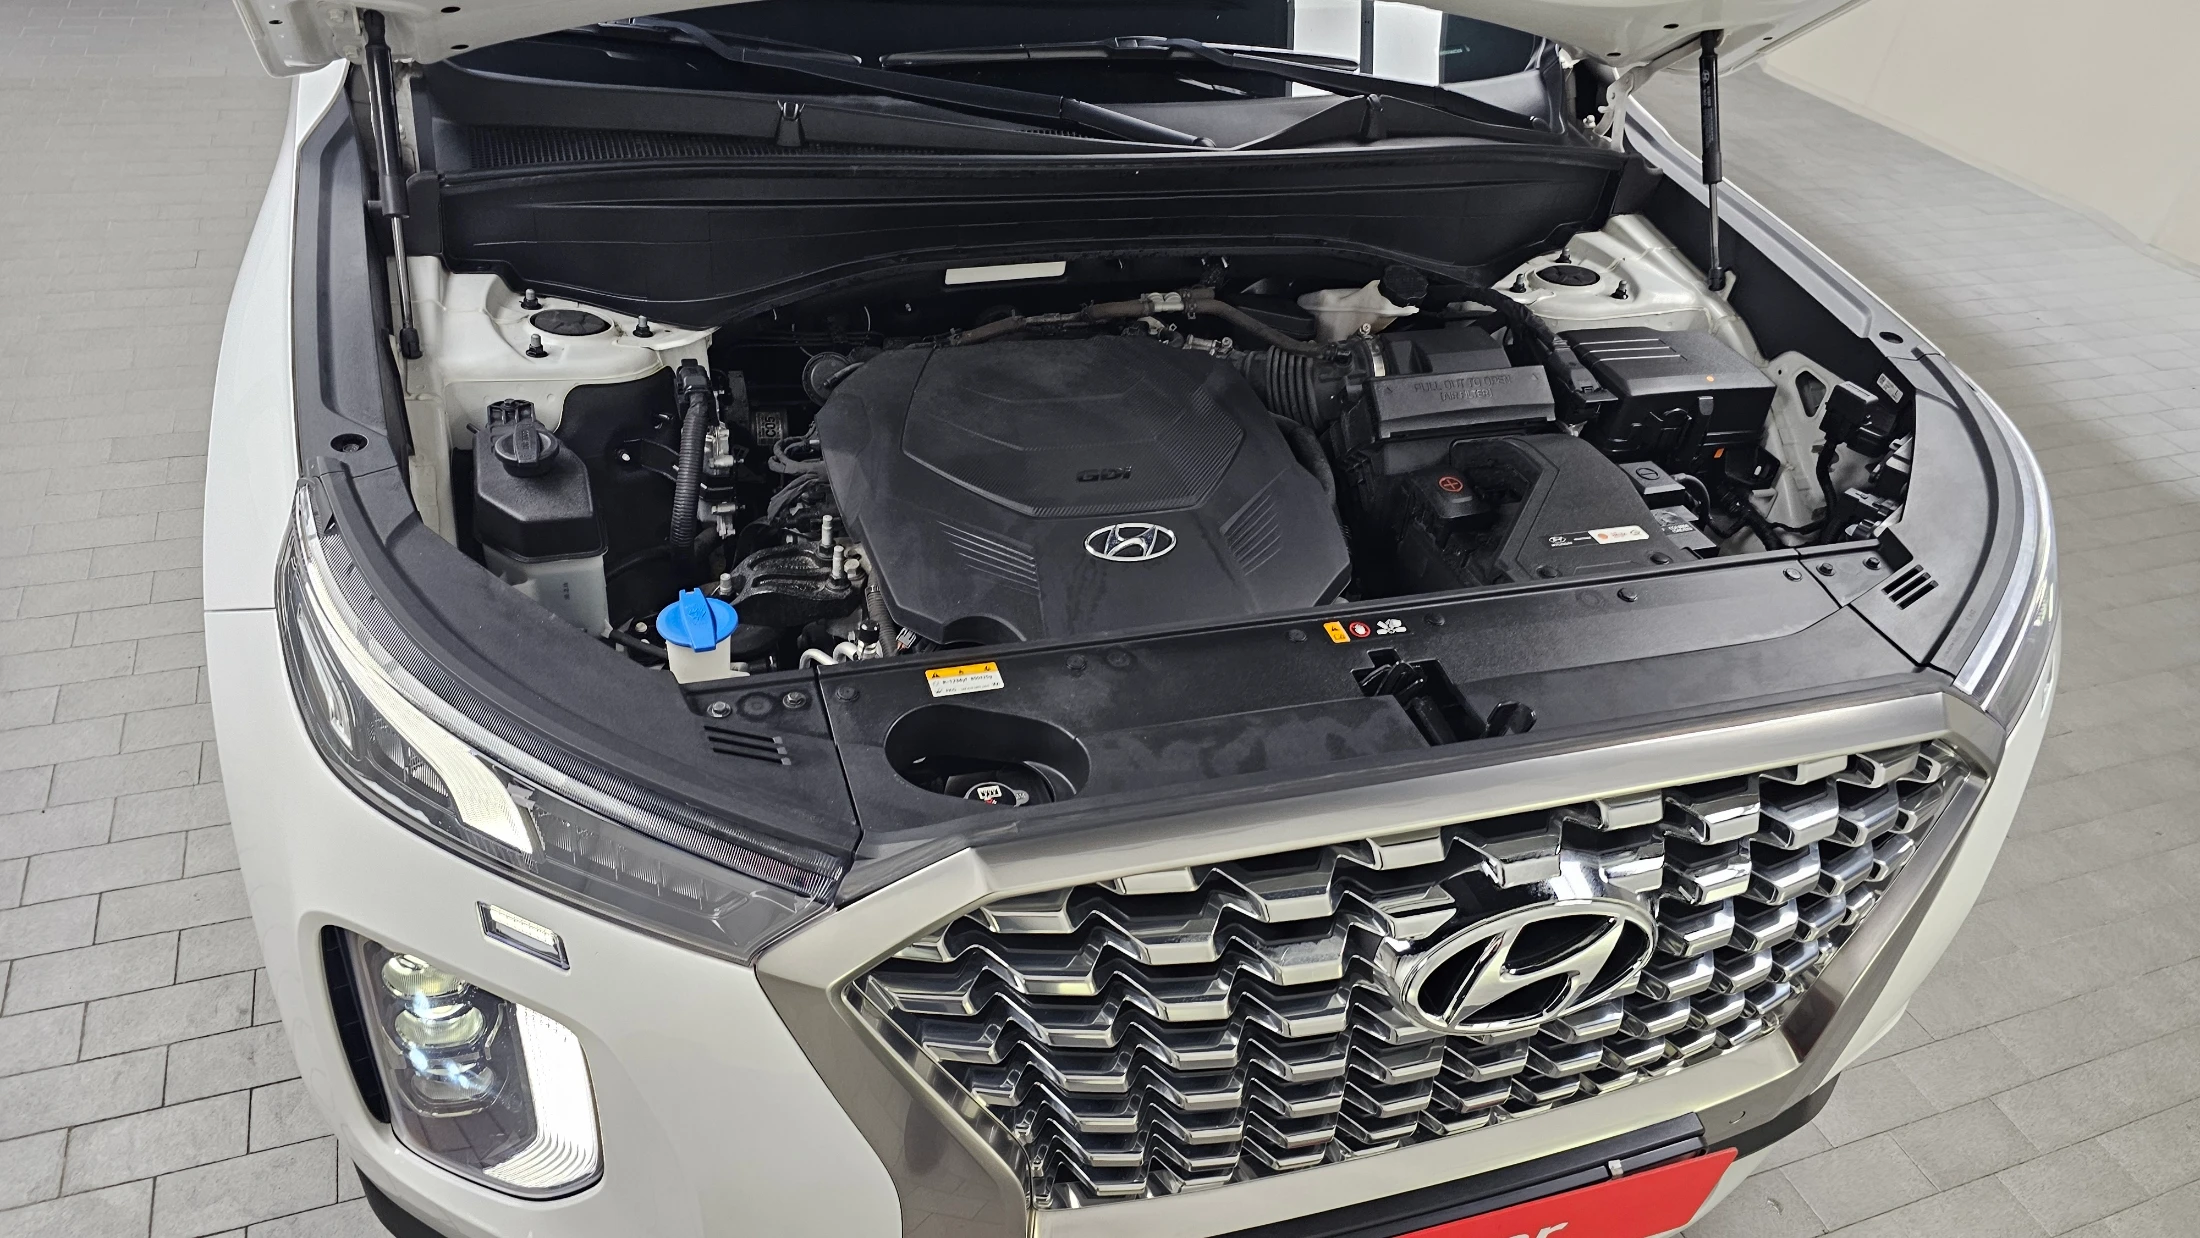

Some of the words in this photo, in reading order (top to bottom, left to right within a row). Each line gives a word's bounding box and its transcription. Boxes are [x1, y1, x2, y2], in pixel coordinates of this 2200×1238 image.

[1414, 381, 1442, 392] PULL
[1445, 378, 1465, 389] OUT
[1467, 377, 1482, 388] TO
[1484, 374, 1511, 386] OPEN
